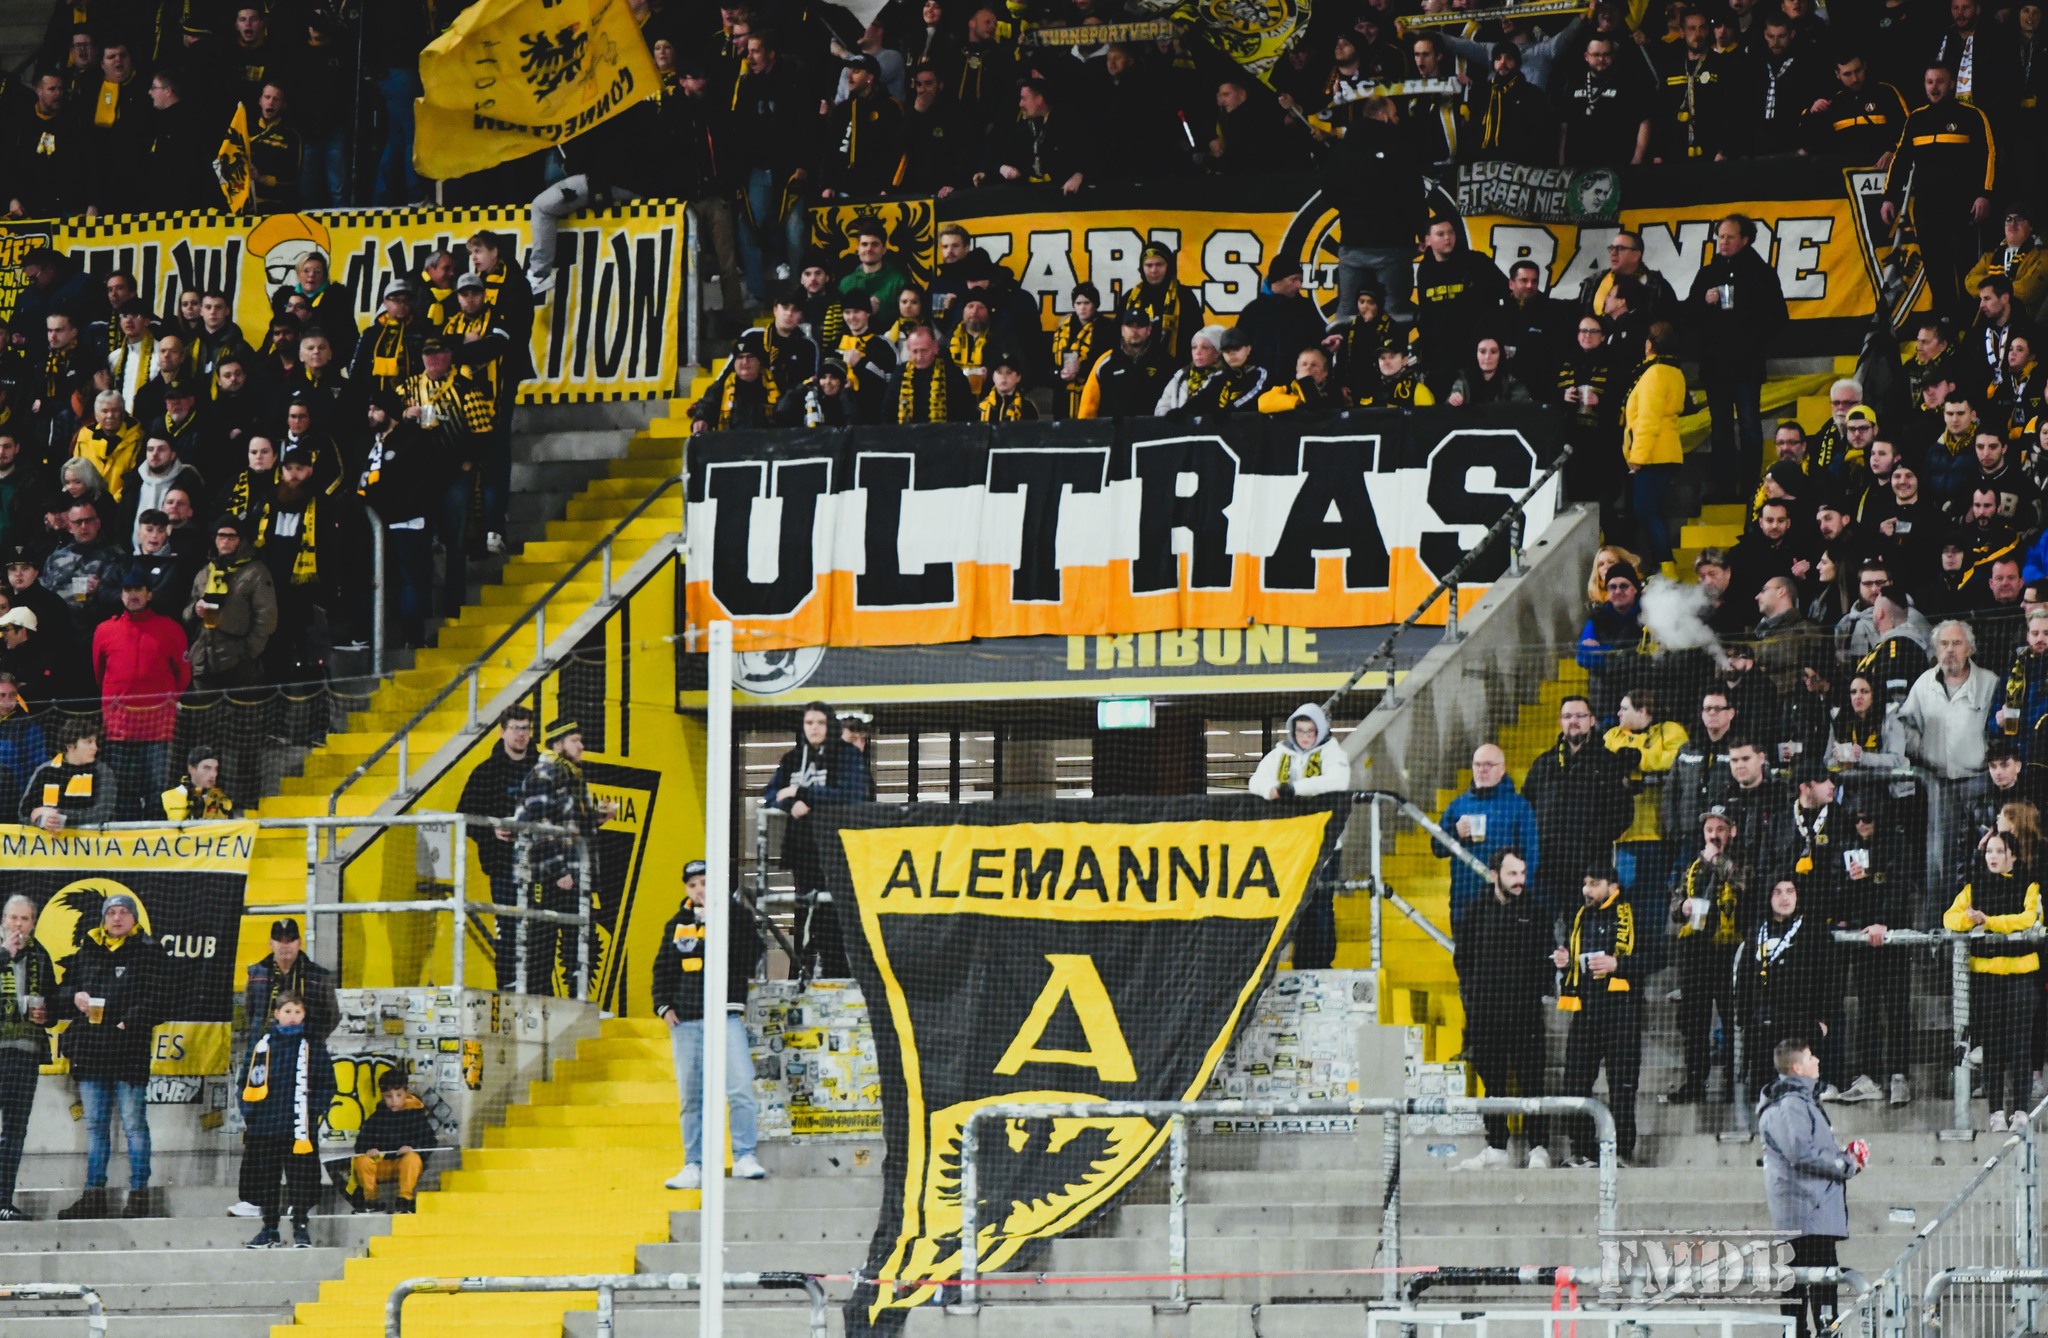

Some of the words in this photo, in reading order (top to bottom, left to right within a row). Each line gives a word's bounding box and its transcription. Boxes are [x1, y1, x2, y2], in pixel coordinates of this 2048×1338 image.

[704, 428, 1539, 622] ULTRAS
[1066, 624, 1319, 672] TRIBUNE
[3, 835, 123, 857] MANNIA
[132, 834, 253, 859] AACHEN
[880, 844, 1281, 903] ALEMANNIA
[160, 934, 217, 958] CLUB
[992, 953, 1138, 1083] A
